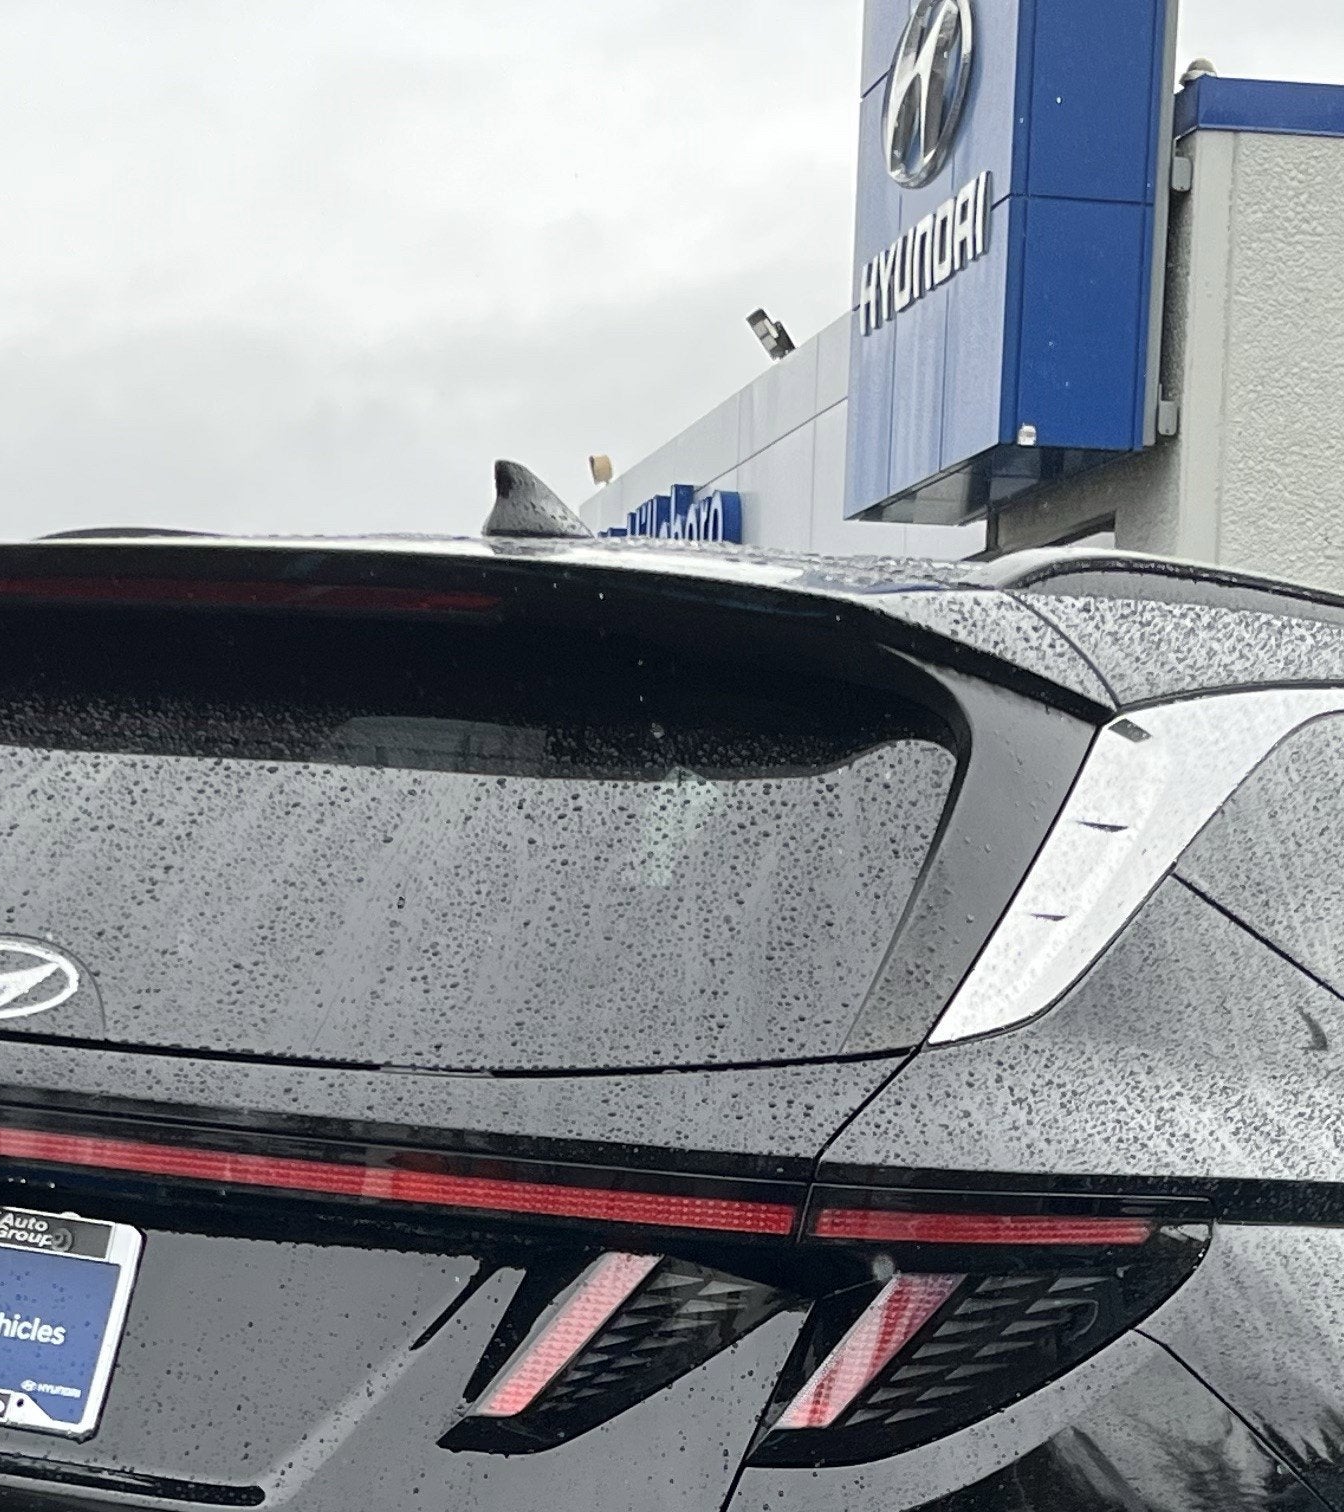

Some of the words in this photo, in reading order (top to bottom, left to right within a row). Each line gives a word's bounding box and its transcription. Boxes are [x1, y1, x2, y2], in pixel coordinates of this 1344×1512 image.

[859, 170, 991, 337] HYUNDAI
[627, 485, 723, 541] llboro
[2, 1212, 49, 1232] Auto
